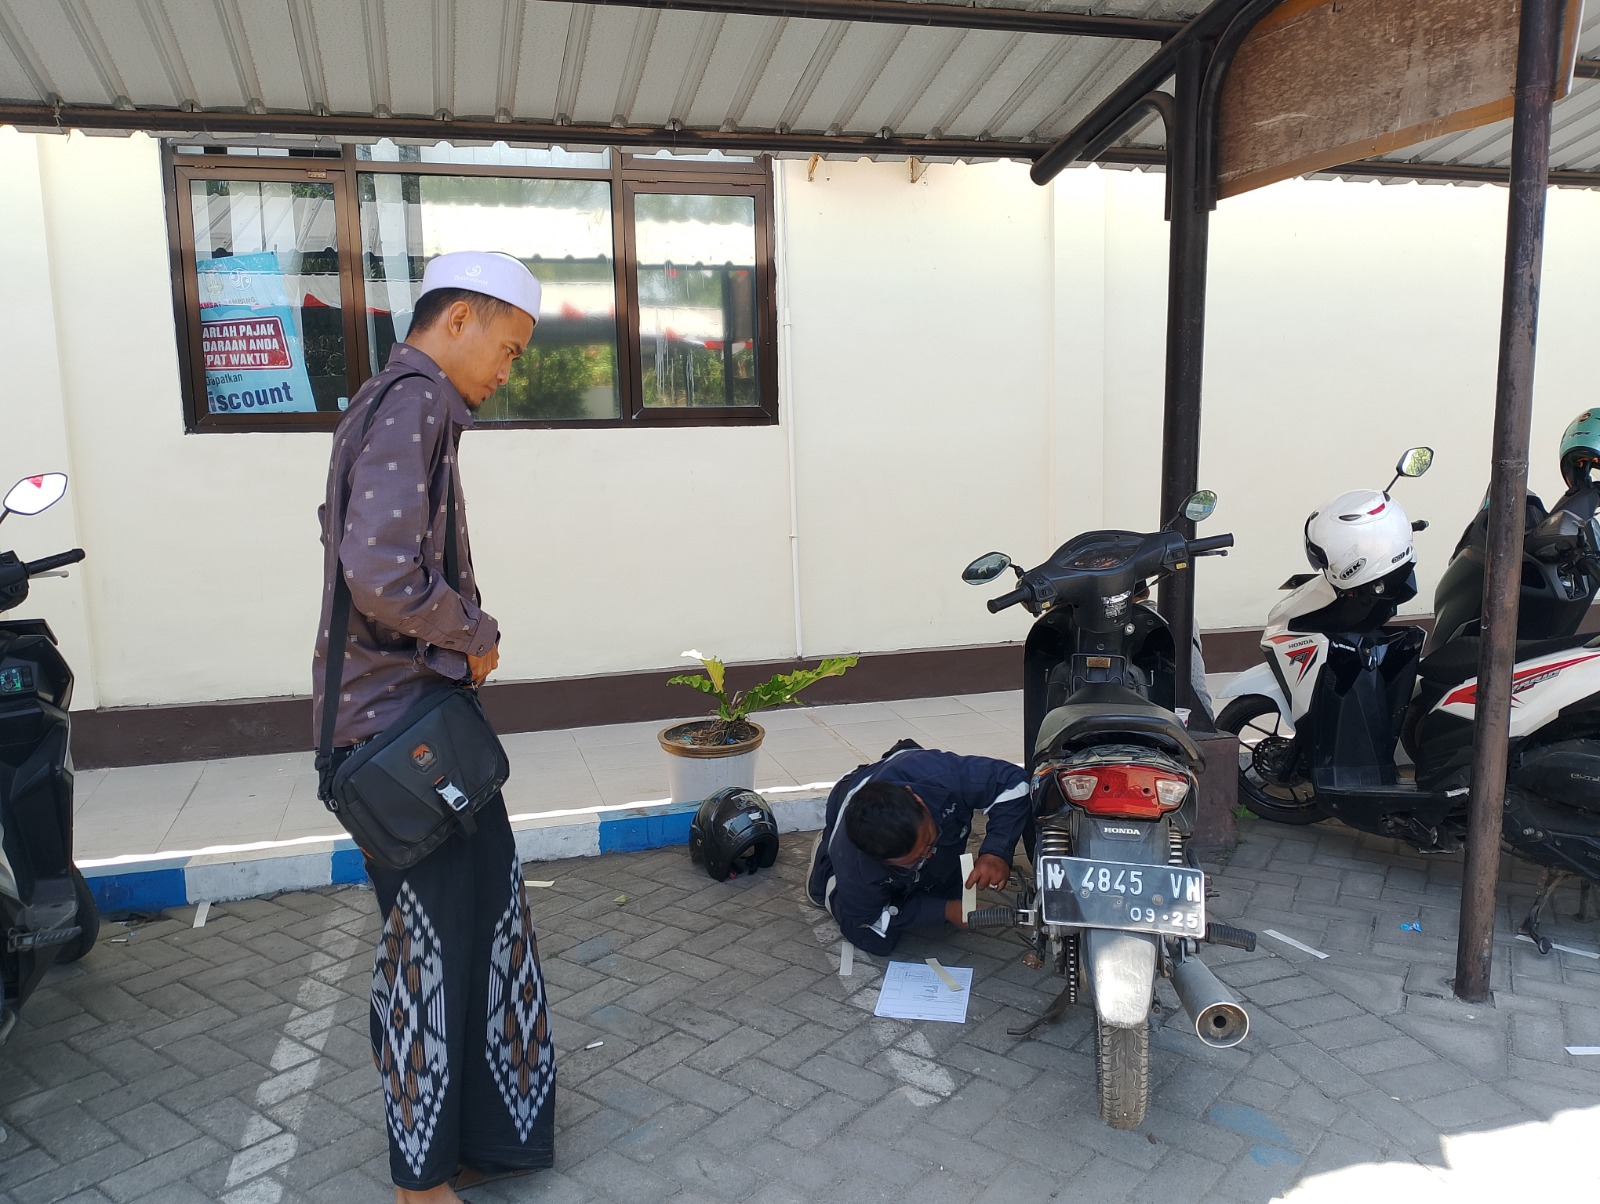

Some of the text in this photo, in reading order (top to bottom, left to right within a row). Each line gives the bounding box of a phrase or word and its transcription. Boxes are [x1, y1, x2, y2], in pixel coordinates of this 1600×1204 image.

[203, 324, 275, 338] ARLAH PAJAK
[203, 338, 279, 352] DARAAN ANDA
[205, 353, 269, 366] PAT WAKTU
[1343, 561, 1361, 579] INK
[1288, 638, 1314, 649] HONDA
[1103, 827, 1141, 836] HONDA
[1081, 866, 1143, 896] 4845
